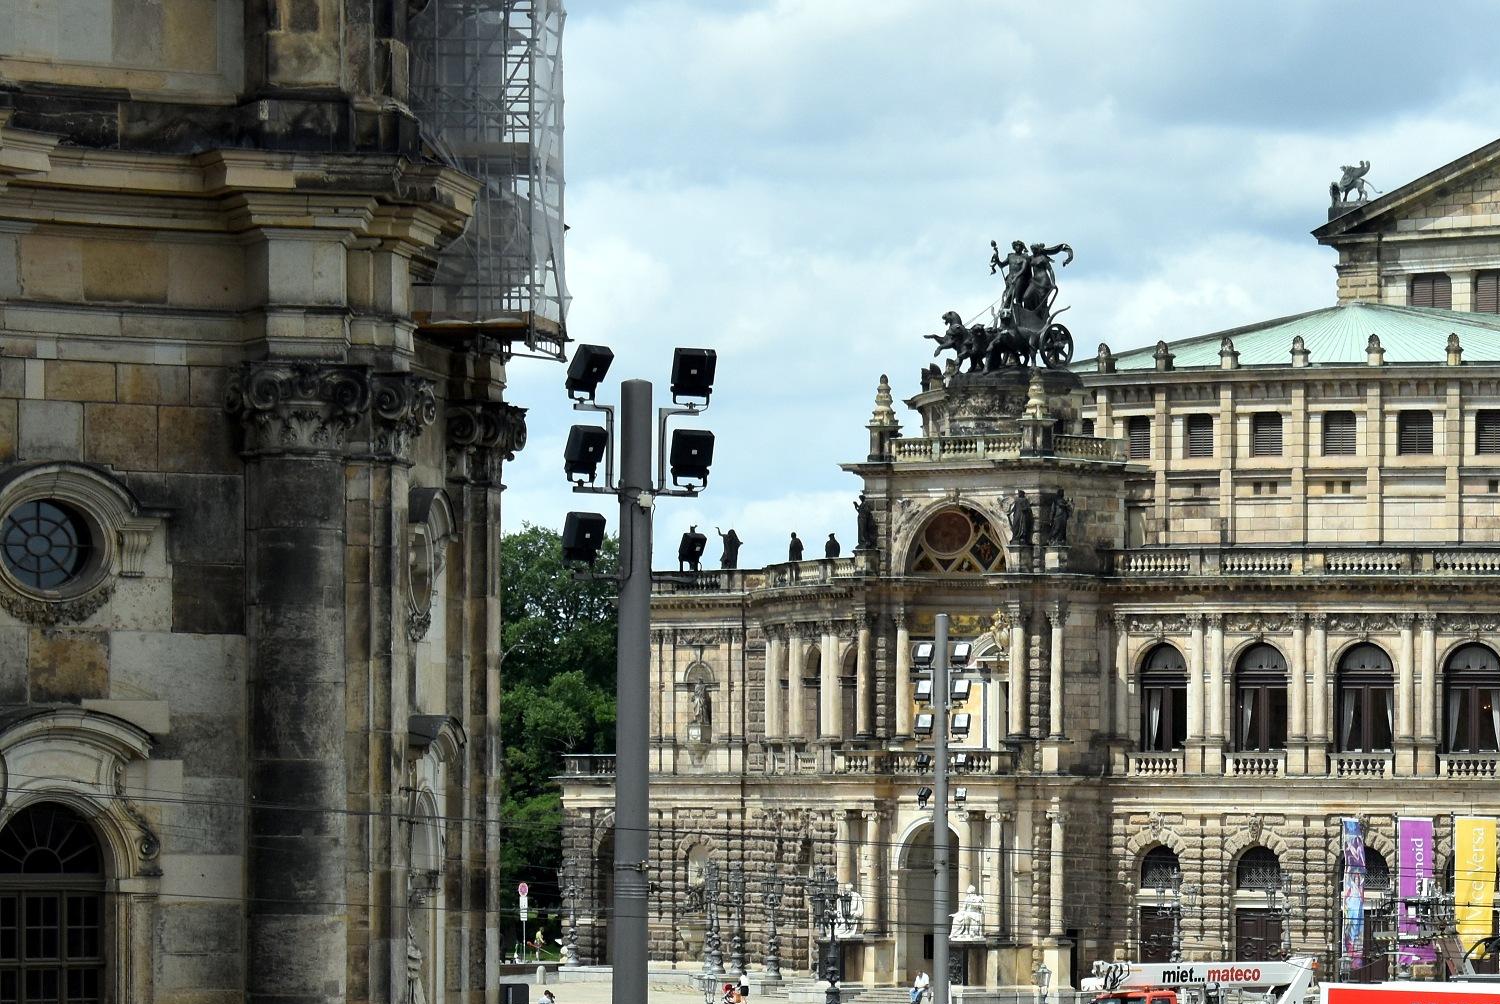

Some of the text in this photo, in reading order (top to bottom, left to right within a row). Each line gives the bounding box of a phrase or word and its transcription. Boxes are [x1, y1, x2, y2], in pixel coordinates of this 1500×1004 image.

[1411, 838, 1424, 895] manoid
[1466, 827, 1485, 876] Versa
[1207, 967, 1261, 982] mateco
